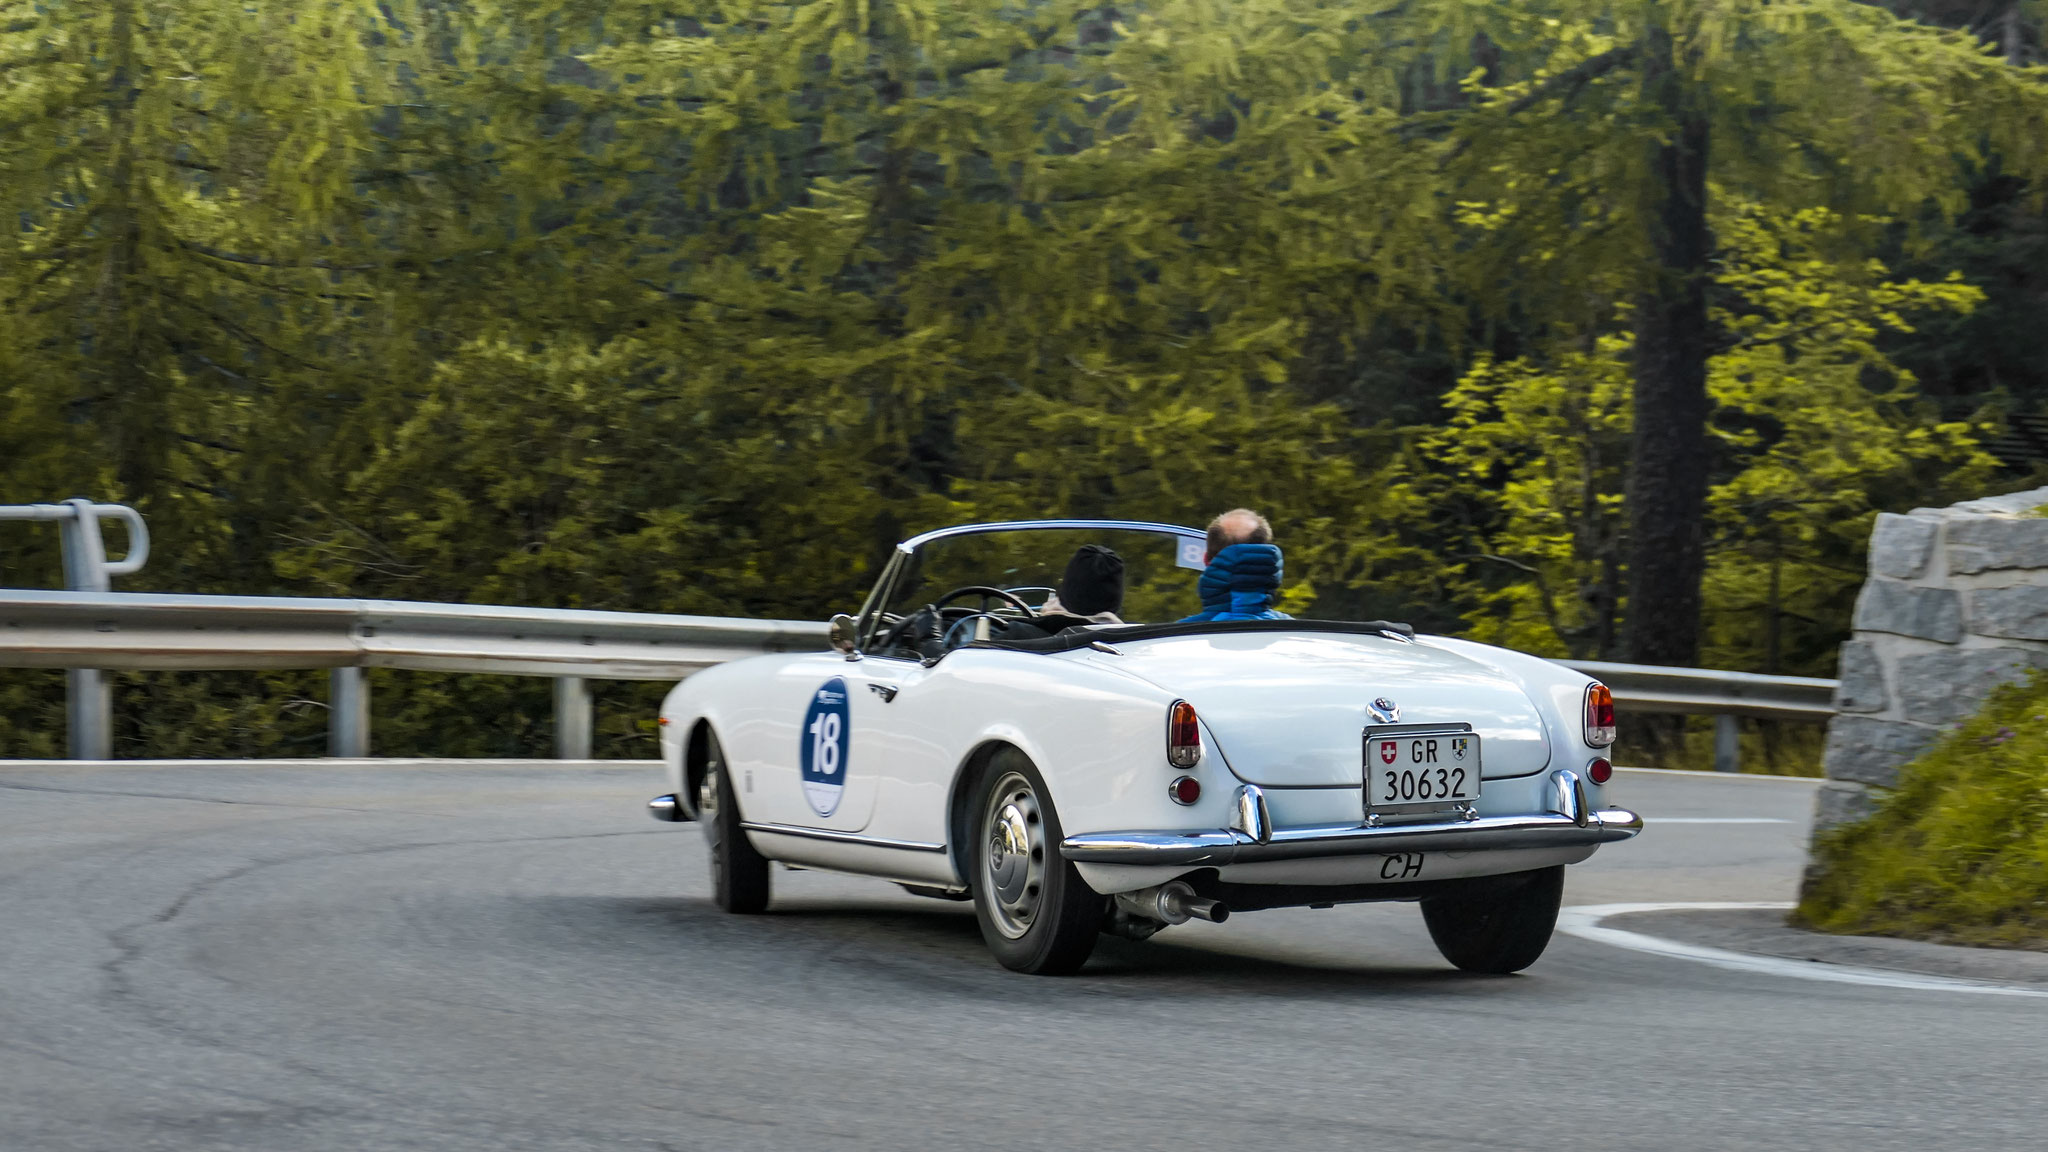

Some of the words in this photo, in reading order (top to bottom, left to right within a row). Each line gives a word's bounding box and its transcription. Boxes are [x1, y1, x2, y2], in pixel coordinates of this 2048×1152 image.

[809, 712, 841, 775] 18
[1411, 739, 1438, 763] GR
[1384, 767, 1466, 801] 30632
[1380, 853, 1424, 879] CH
